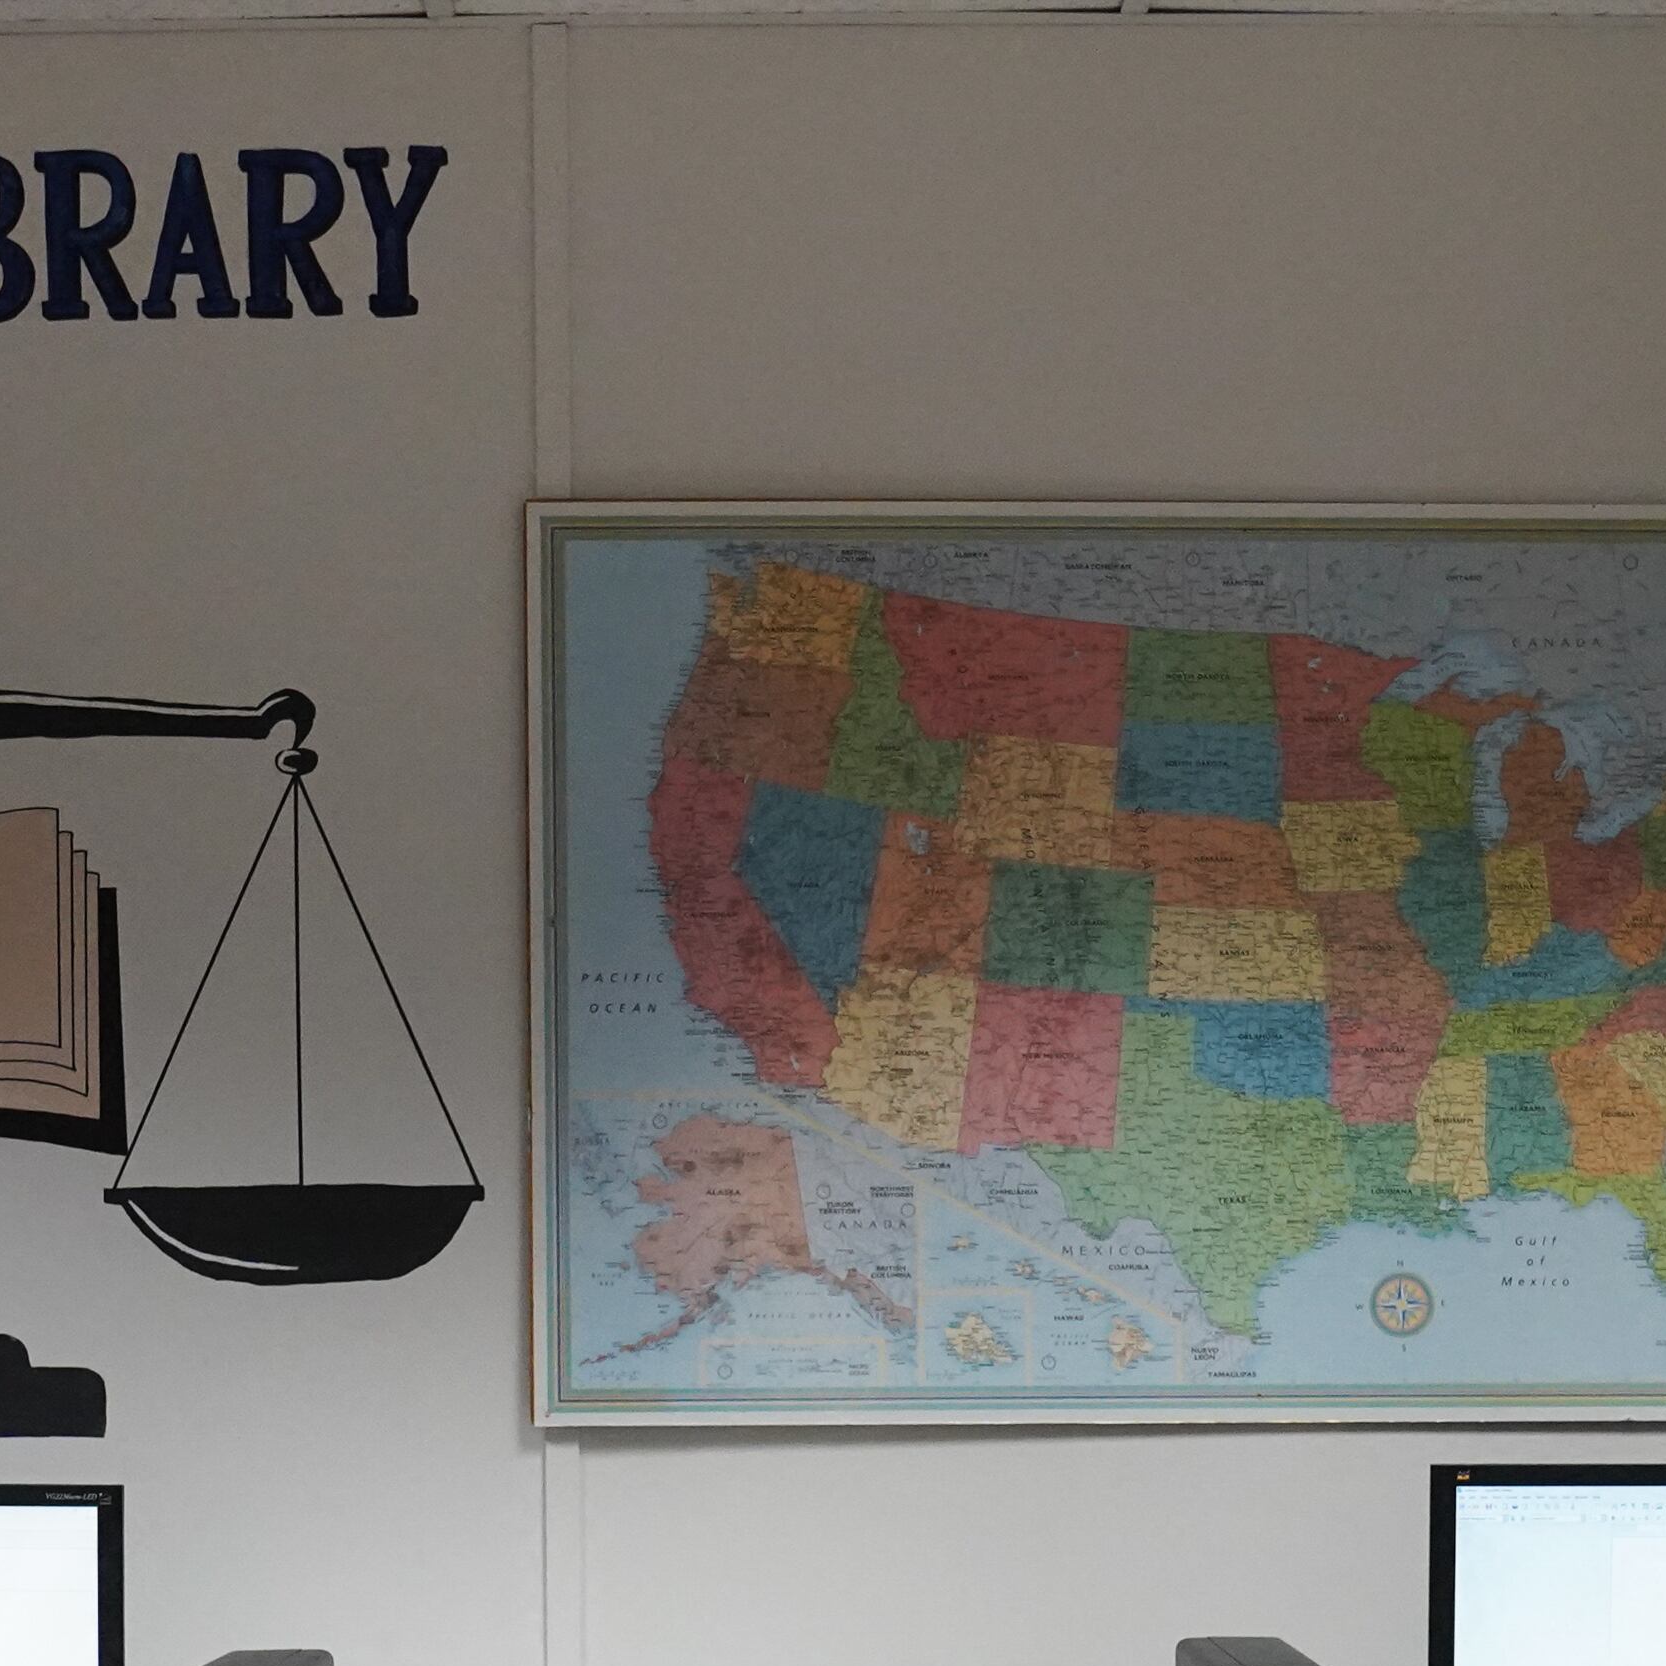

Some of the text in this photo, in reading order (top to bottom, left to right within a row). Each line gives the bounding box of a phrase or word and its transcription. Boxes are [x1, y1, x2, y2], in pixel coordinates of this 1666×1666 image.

[1511, 637, 1603, 649] CANADA
[581, 972, 665, 983] PACIFIC
[589, 1003, 658, 1014] OCEAN
[918, 1162, 951, 1170] SONORA
[705, 1188, 741, 1197] ALASKA
[1218, 1197, 1247, 1205] TEXAS
[823, 1219, 909, 1231] CANADA
[1514, 1236, 1558, 1247] Gulf
[1062, 1244, 1146, 1256] MEXICO
[1526, 1256, 1546, 1267] of
[1501, 1276, 1571, 1287] Mexico
